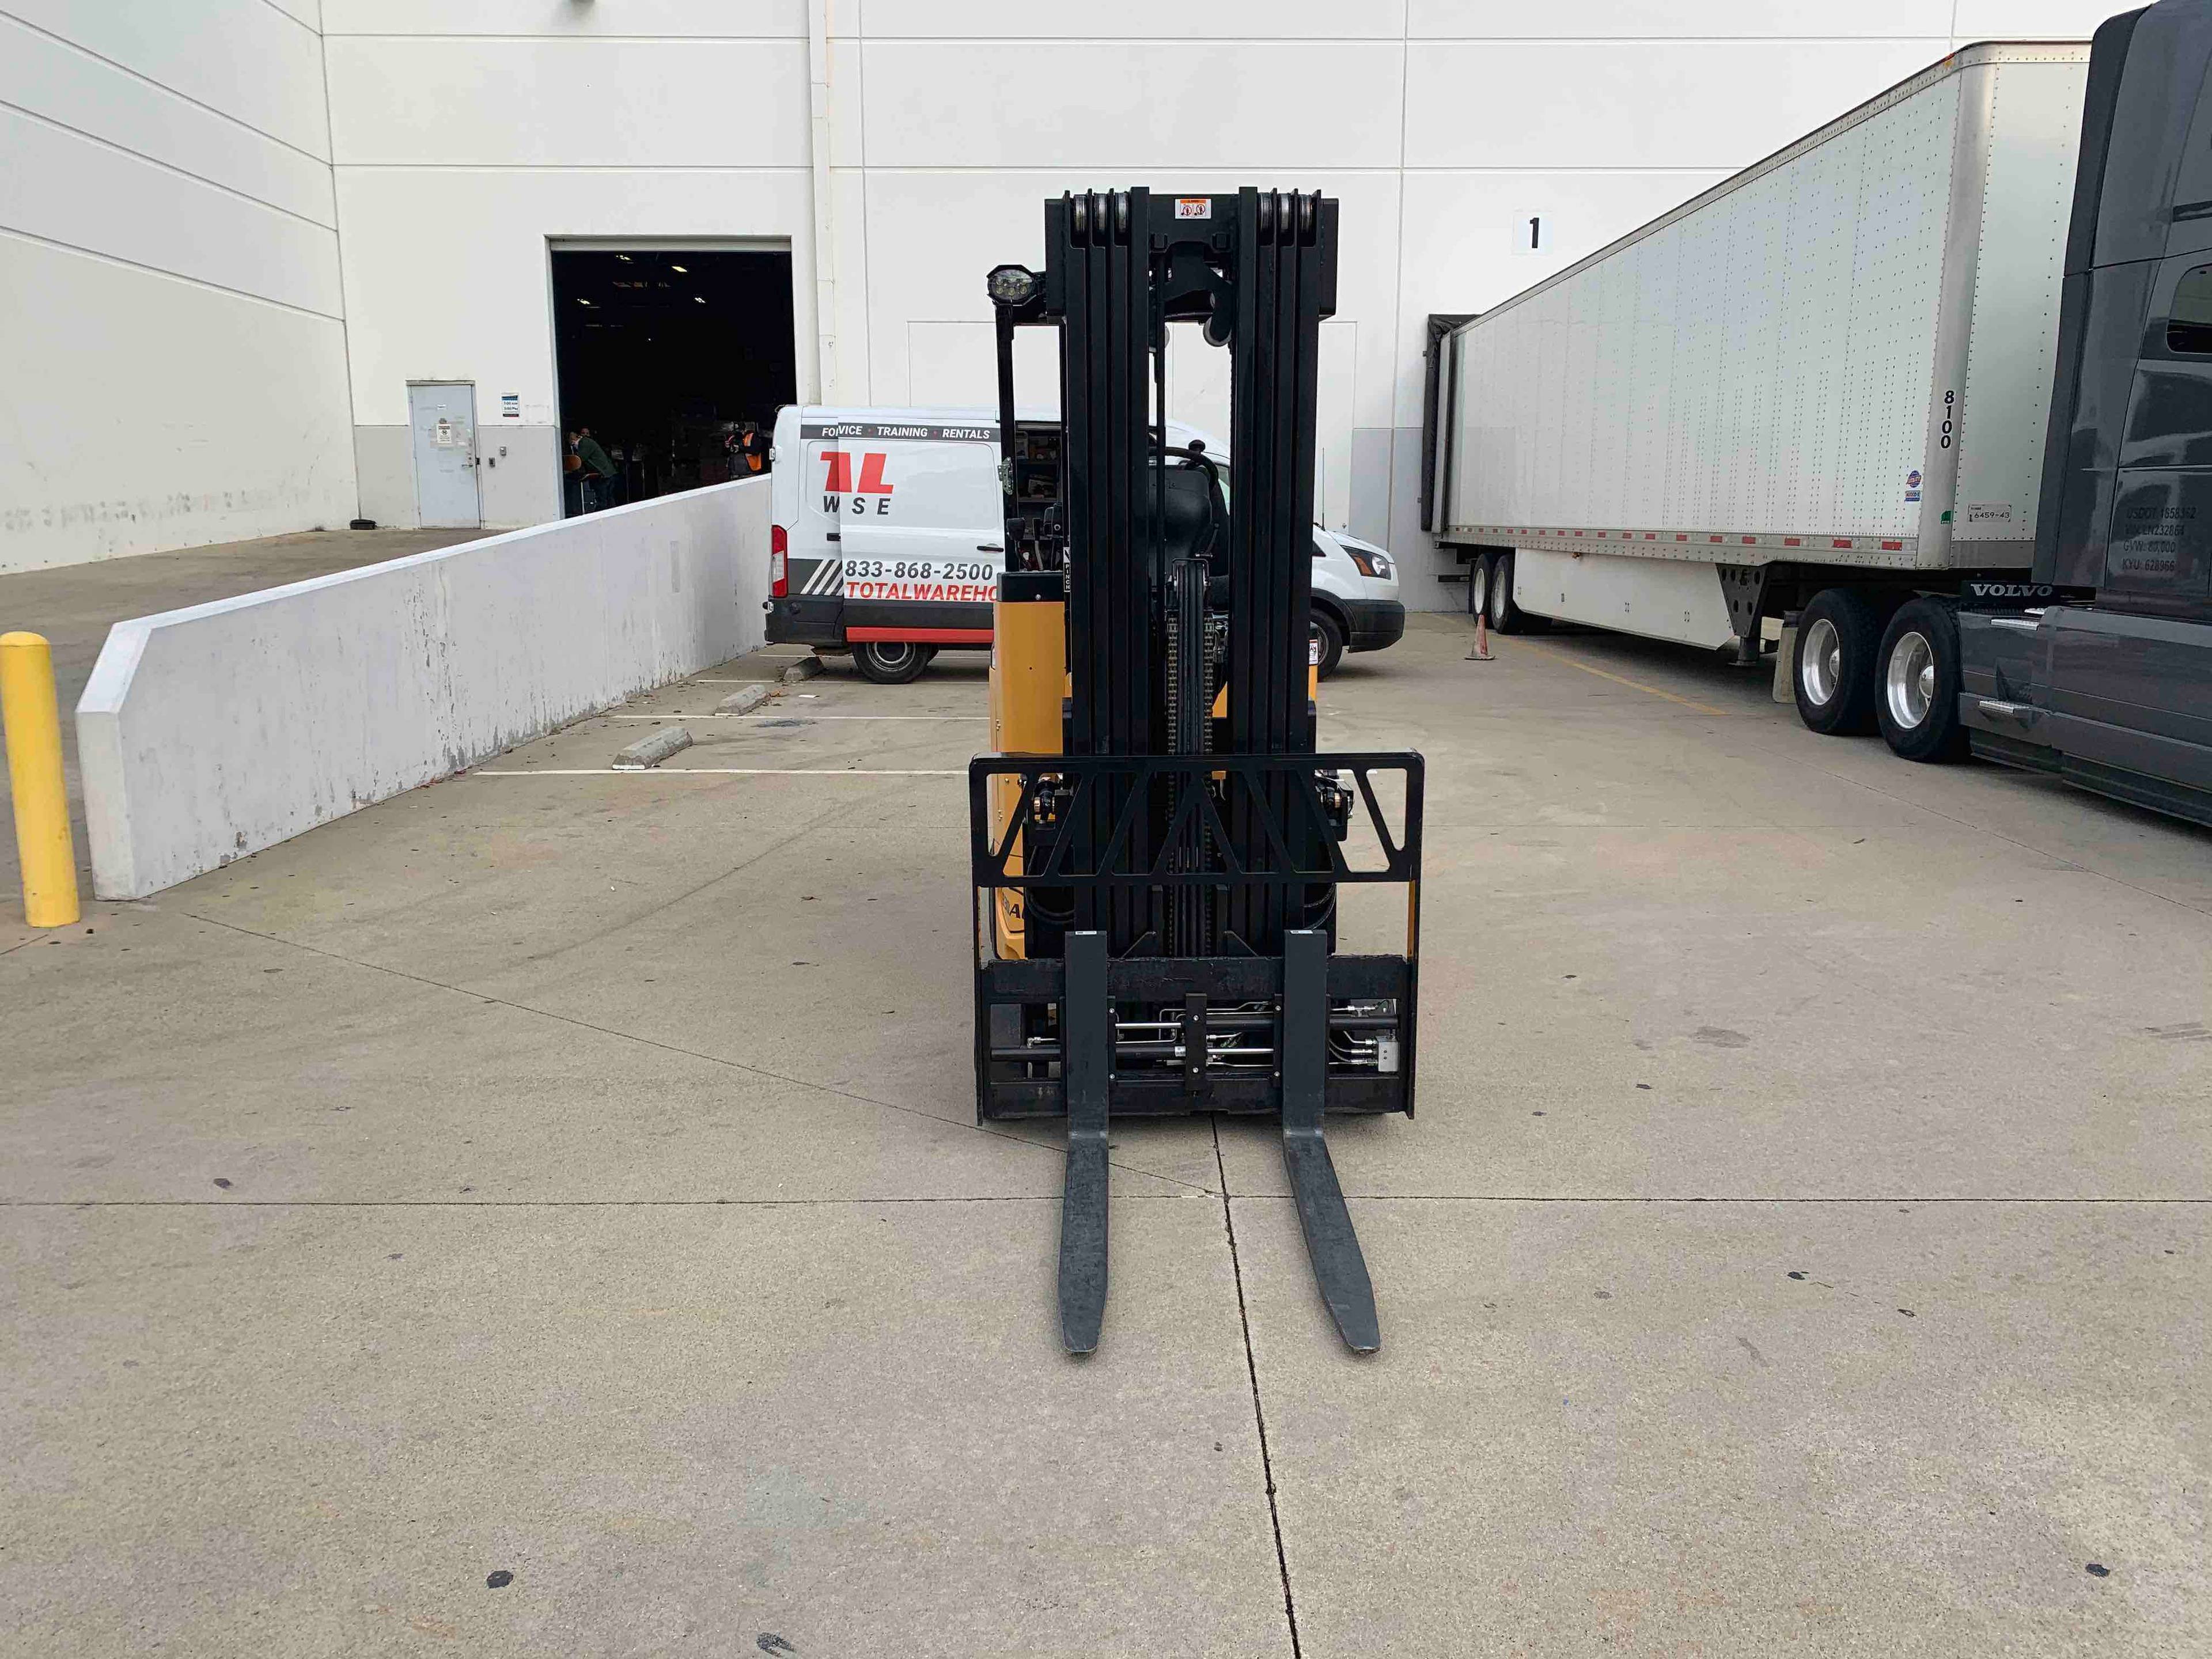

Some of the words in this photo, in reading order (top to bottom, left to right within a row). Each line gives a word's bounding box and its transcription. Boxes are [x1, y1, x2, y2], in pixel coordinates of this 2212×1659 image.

[1529, 217, 1539, 248] 1
[1941, 390, 1955, 449] 8100
[877, 426, 928, 437] TRAINING
[942, 429, 990, 439] RENTALS
[845, 560, 993, 581] 833-868-2500
[1971, 584, 2053, 597] VOLVO
